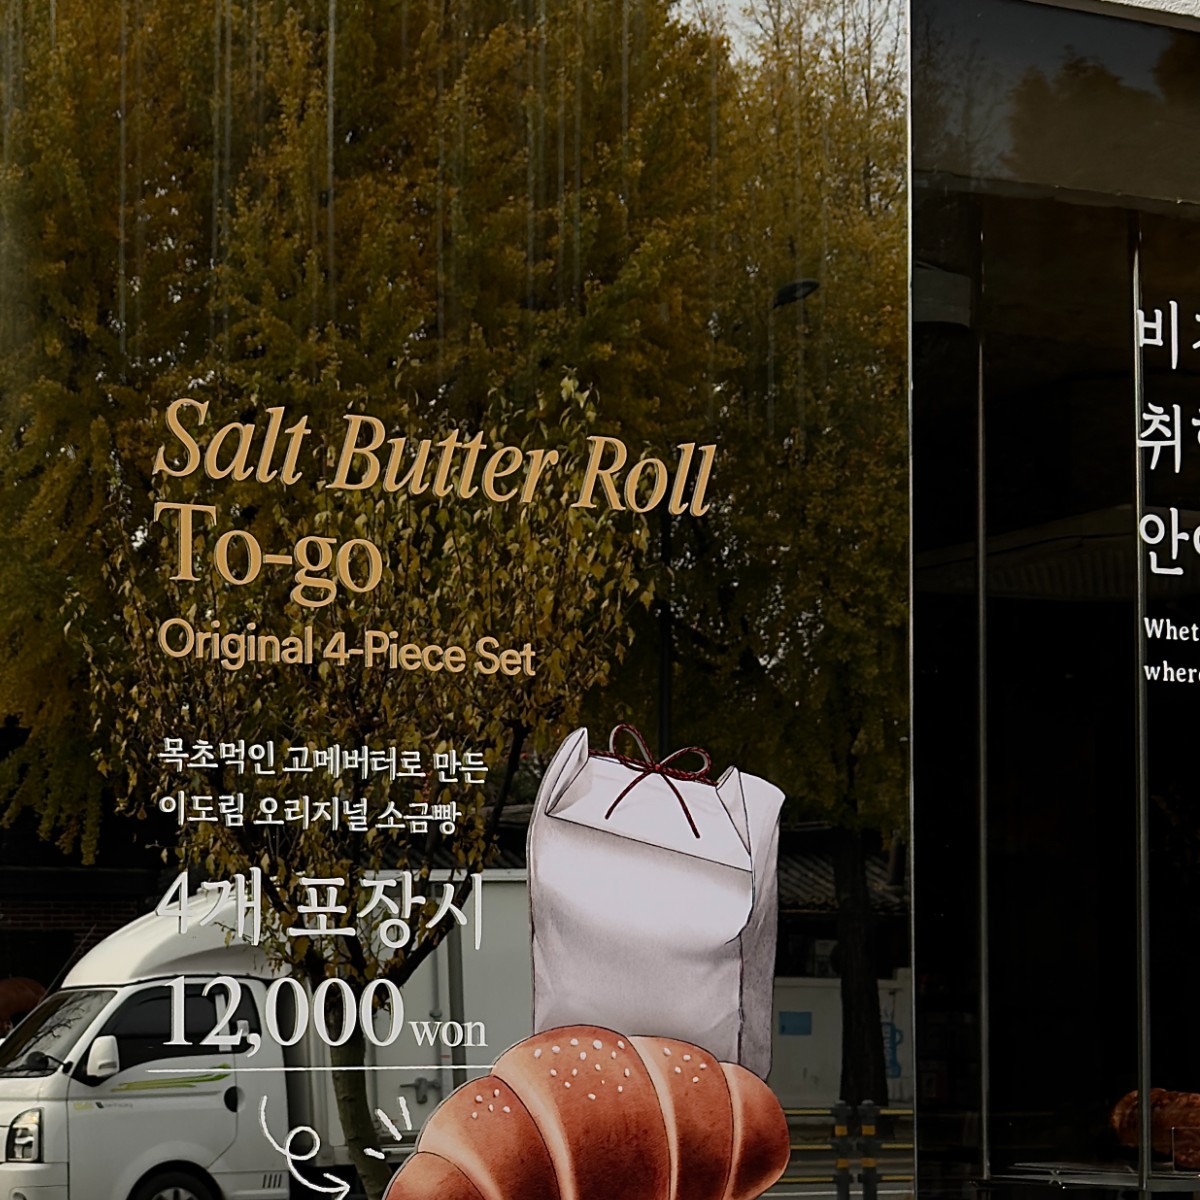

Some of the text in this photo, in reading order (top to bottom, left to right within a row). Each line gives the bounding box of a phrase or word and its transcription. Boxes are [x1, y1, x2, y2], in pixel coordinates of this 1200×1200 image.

[153, 398, 717, 517] Salt Butter Roll
[1137, 402, 1200, 474] 취
[154, 501, 383, 608] To-go
[1139, 507, 1200, 576] 안
[158, 617, 537, 677] Original 4-Piece Set
[1143, 660, 1200, 683] wher
[157, 737, 489, 784] 목초먹인 고메버터로 만든
[158, 790, 462, 835] 이도림 오리지널 소금빵
[155, 867, 483, 950] 4개 포장시
[162, 975, 488, 1058] 12,000 won
